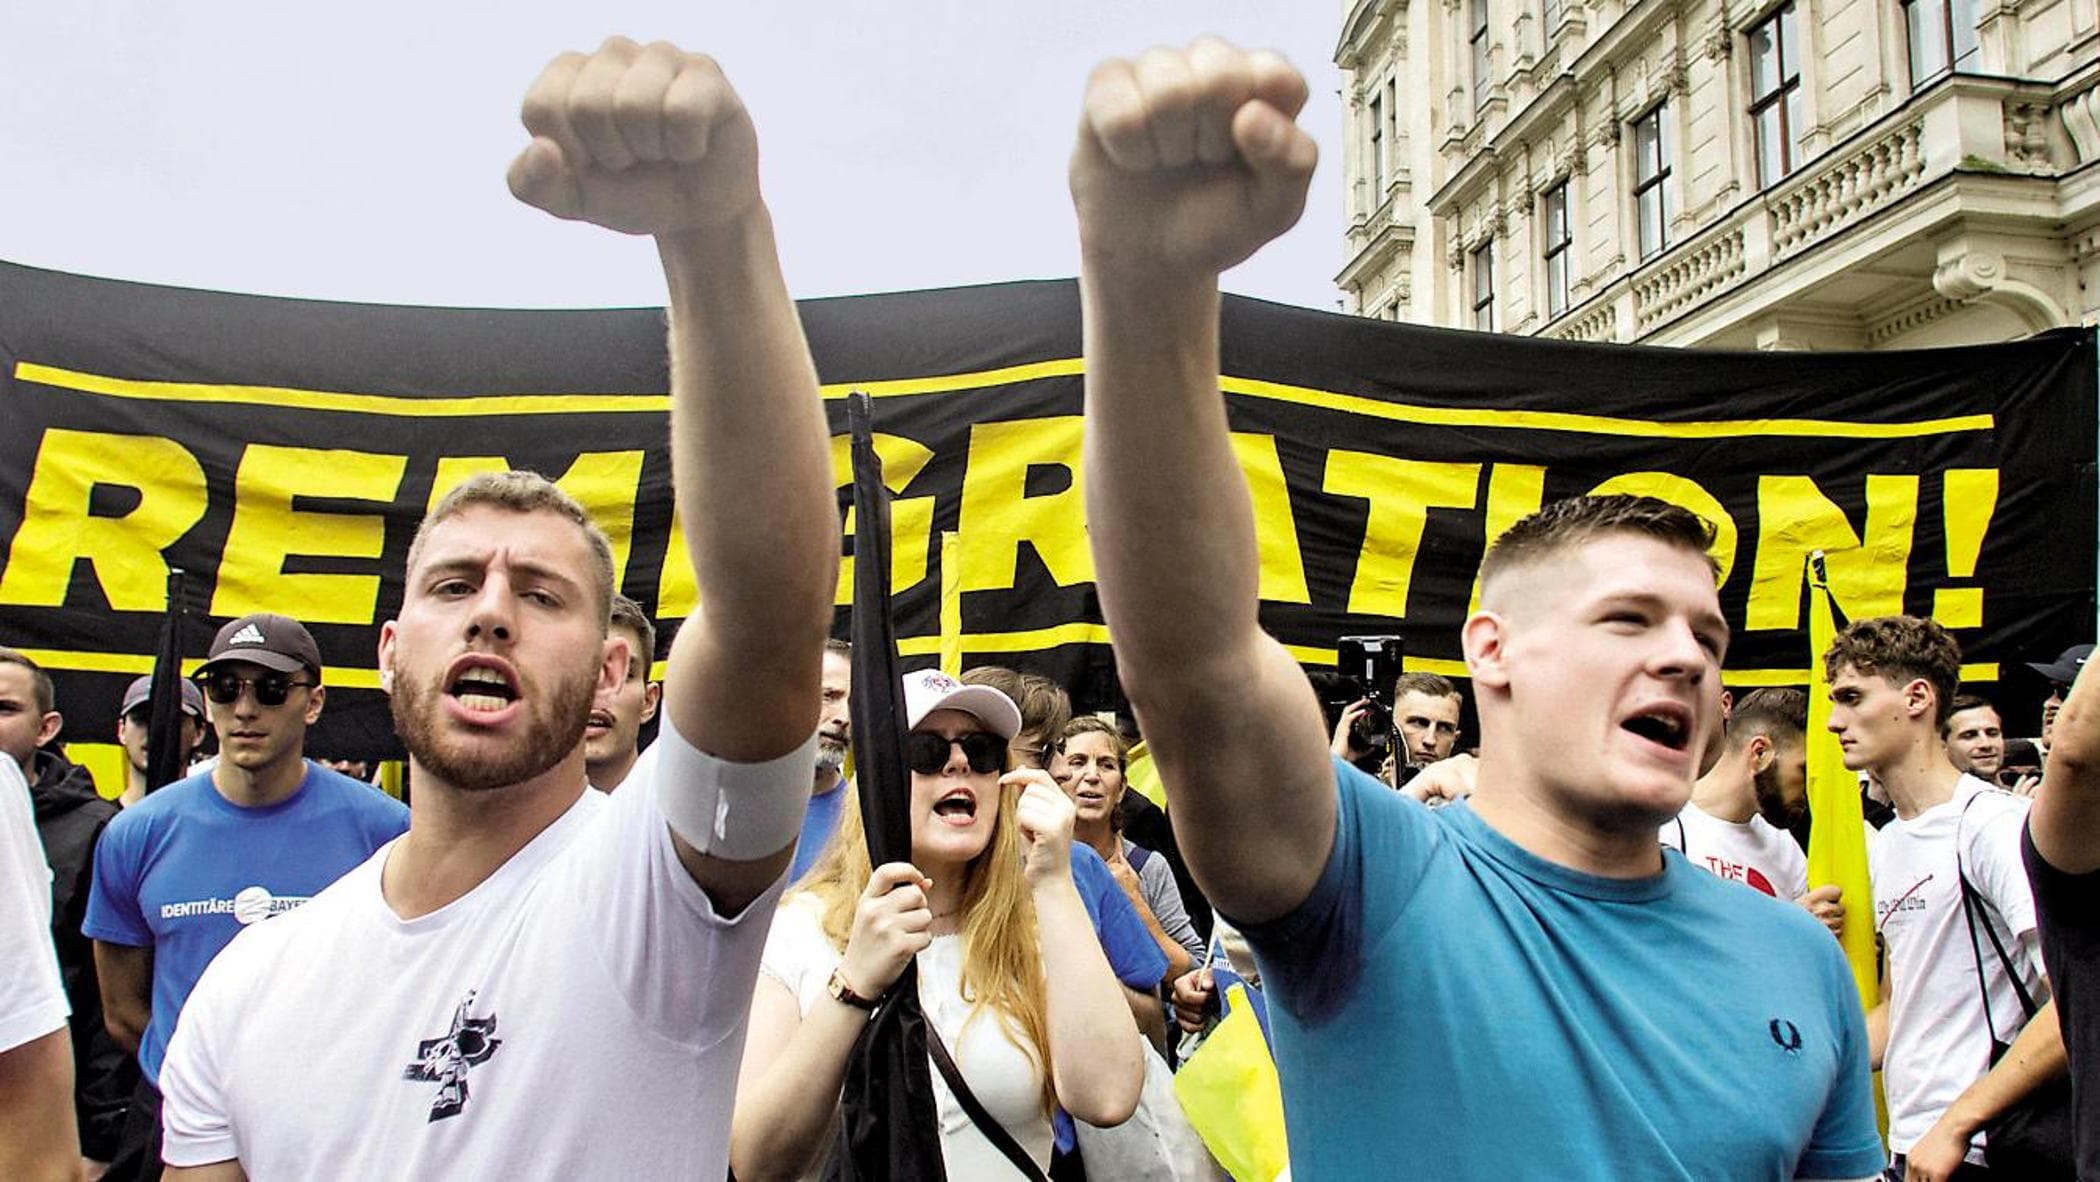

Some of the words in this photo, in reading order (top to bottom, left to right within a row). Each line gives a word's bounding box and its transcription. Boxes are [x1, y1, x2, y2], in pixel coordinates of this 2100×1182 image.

[0, 414, 1999, 632] REGRTN!
[161, 897, 235, 918] IDENTITÄRE
[270, 899, 309, 912] BAYE
